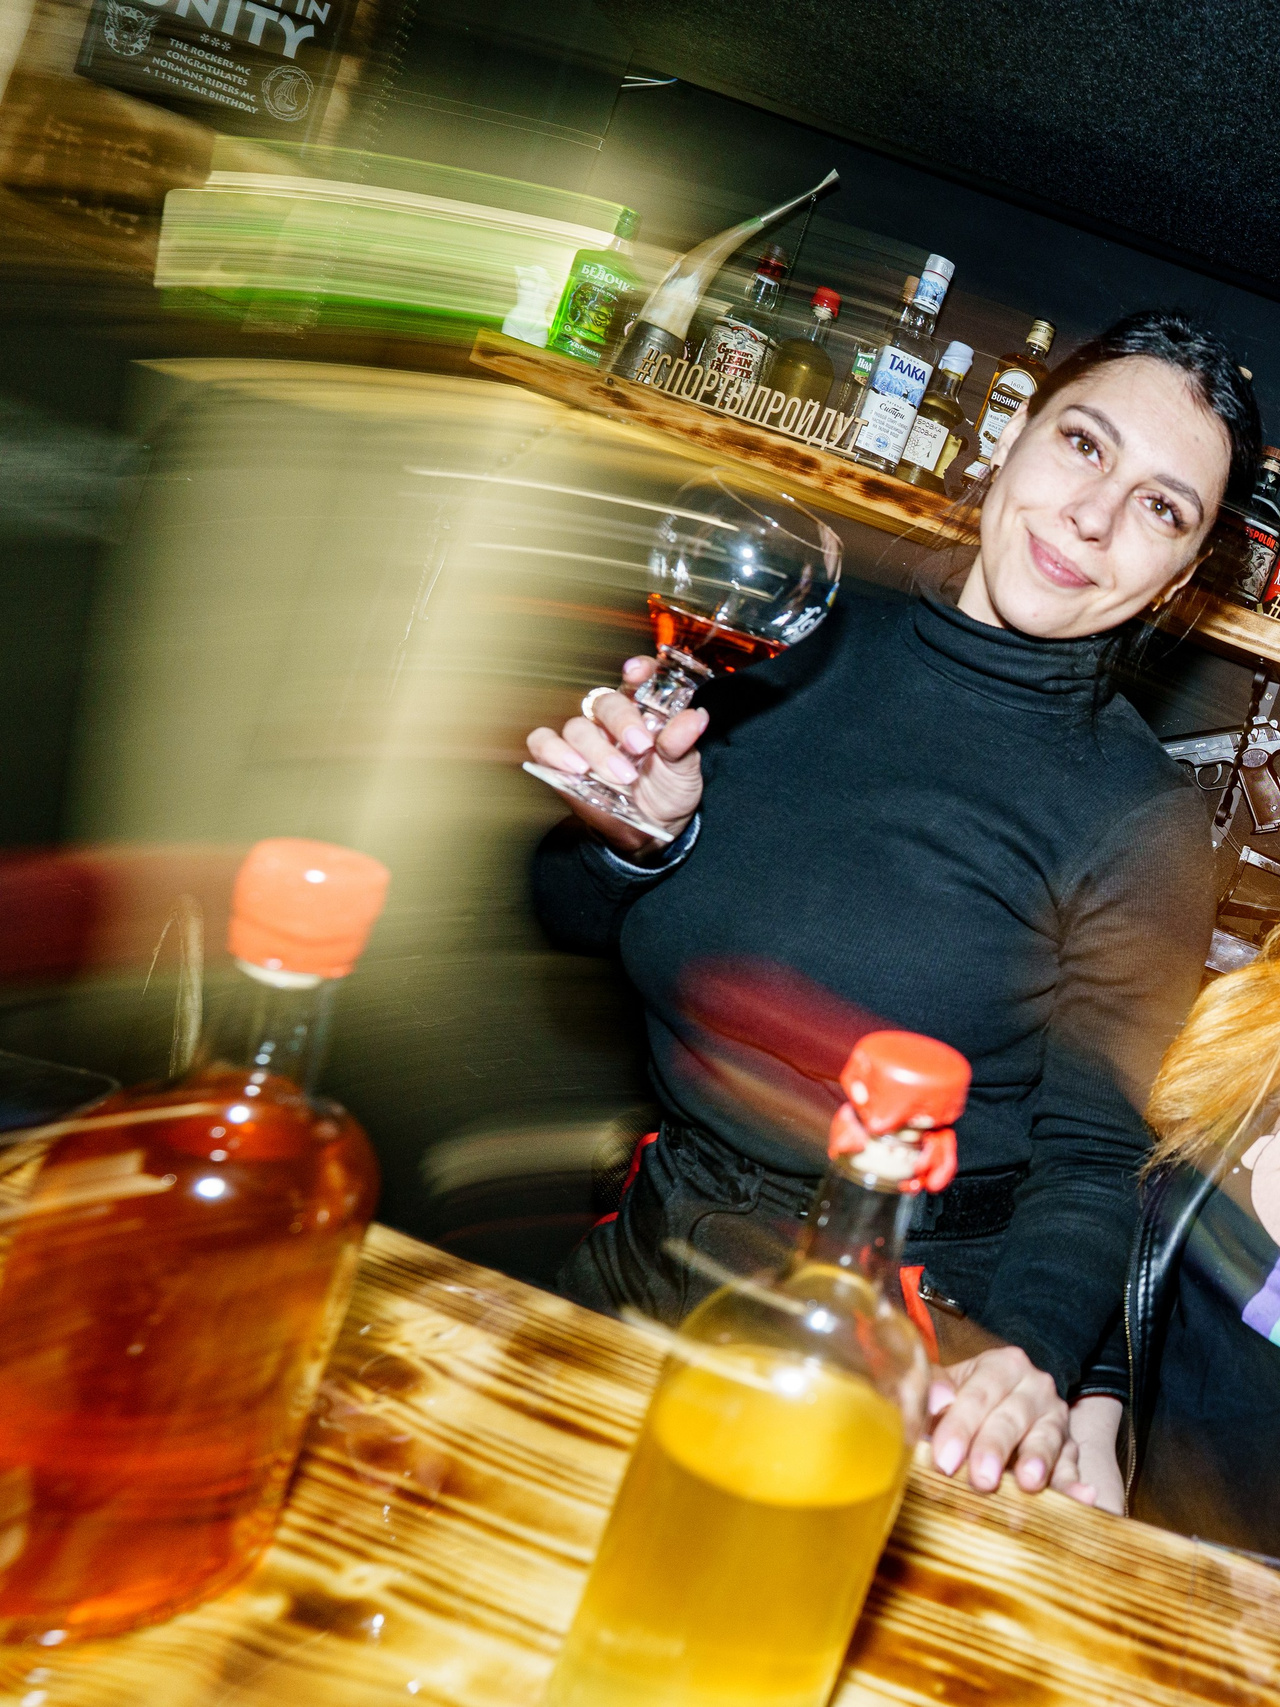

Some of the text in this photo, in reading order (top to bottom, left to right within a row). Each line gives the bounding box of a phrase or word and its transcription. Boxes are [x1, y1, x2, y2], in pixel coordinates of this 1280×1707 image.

[166, 50, 249, 86] CONGRATULATES
[169, 38, 251, 76] THE ROCKERS MC
[142, 65, 151, 74] A
[181, 79, 208, 97] YEAR
[208, 90, 259, 115] BIRTHDAY
[152, 56, 257, 103] NORMANS RIDERS MC
[889, 353, 926, 384] ТАЛКА
[1010, 380, 1025, 390] 1608
[633, 347, 869, 453] #СПОРТЫПРОЙДУТ
[991, 391, 1022, 410] BUSHMI
